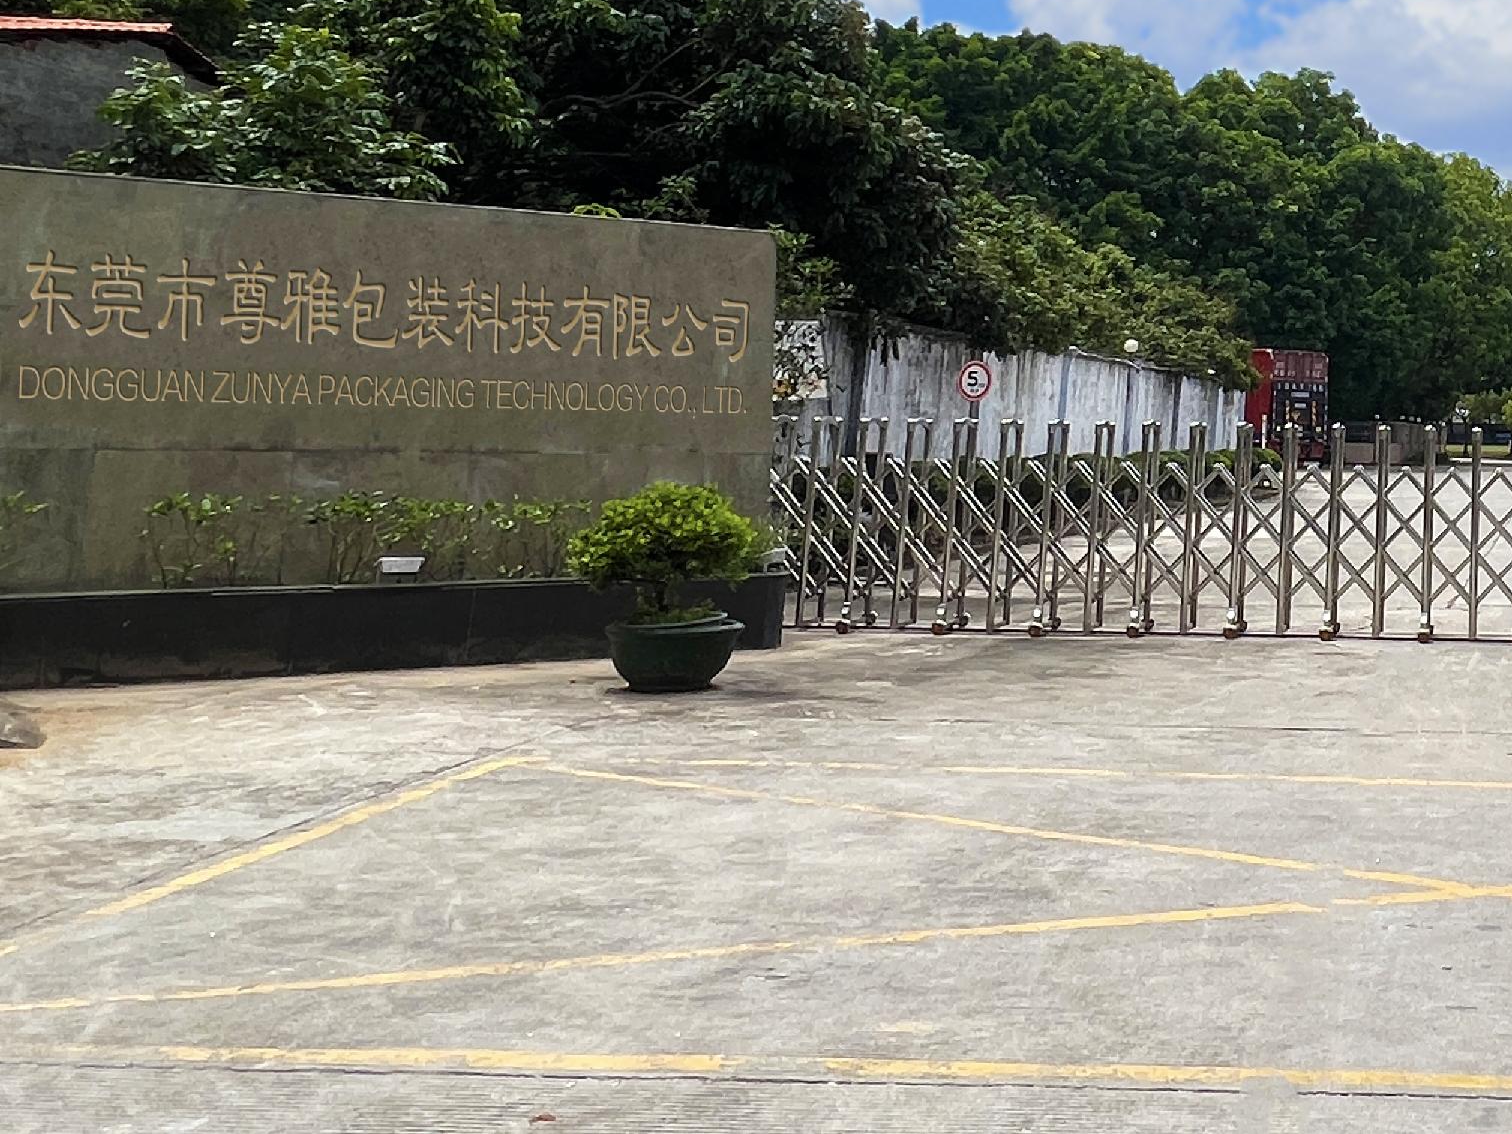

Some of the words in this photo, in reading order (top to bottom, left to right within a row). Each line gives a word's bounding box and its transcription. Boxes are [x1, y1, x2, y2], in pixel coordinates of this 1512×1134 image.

[19, 251, 749, 362] 东莞市尊雅包装科技有限公司
[18, 365, 204, 402] DONGGUAN
[211, 370, 312, 405] ZUNYA
[318, 375, 475, 408] PACKAGING
[482, 380, 648, 412] TECHNOLOGY
[654, 385, 696, 419] CO.,
[702, 386, 747, 414] LTD.
[967, 371, 978, 387] 5
